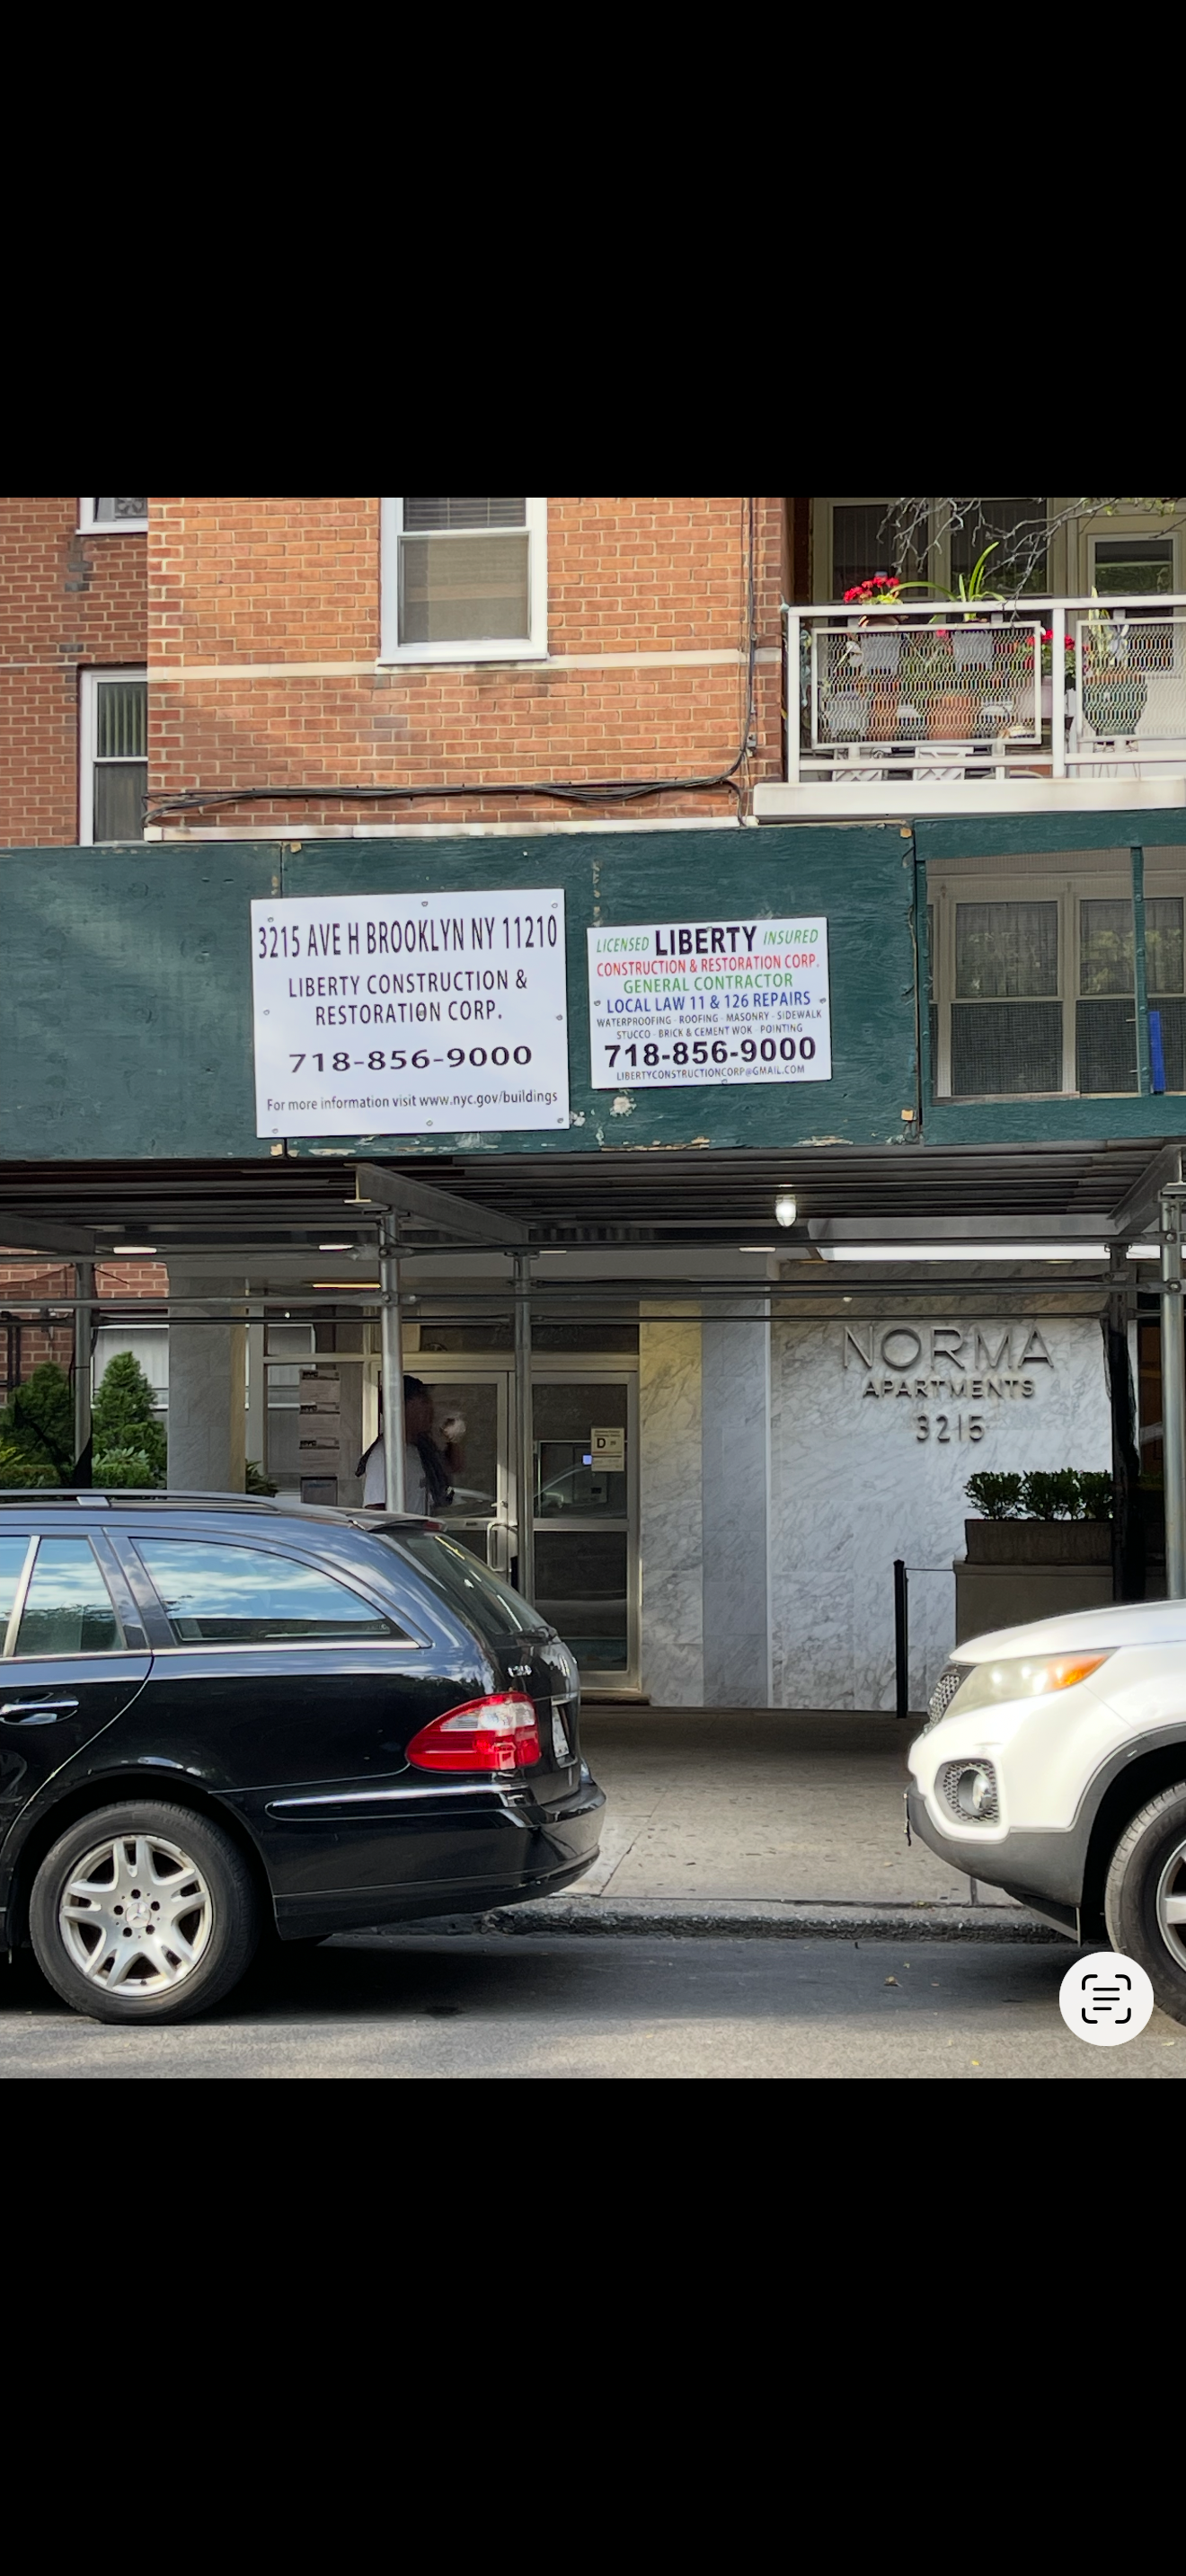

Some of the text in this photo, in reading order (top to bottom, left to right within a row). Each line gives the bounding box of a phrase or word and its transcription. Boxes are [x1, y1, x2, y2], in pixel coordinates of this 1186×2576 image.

[259, 914, 557, 958] 3215 AVE H BROOKLYN NY 11210
[597, 937, 649, 953] LICENSED
[656, 926, 757, 956] LIBERTY
[764, 930, 819, 945] INSURED
[597, 954, 819, 976] CONSTRUCTION & RESTORATION CORP.
[289, 969, 527, 998] LIBERTY CONSTRUCTION &
[624, 974, 792, 993] GENERAL CONTRACTOR
[316, 1000, 502, 1026] RESTORATION CORP.
[607, 992, 810, 1013] LOCAL LAW 11 & 126 REPAIRS
[597, 1016, 671, 1028] WATERPROOFING
[679, 1014, 718, 1023] ROOFING
[727, 1011, 768, 1022] MASONRY
[777, 1010, 821, 1019] SIDEWALK
[616, 1029, 651, 1039] STUCCO
[659, 1028, 683, 1037] BRICK
[686, 1028, 692, 1037] &
[695, 1026, 729, 1037] CEMENT
[731, 1026, 752, 1036] WOK
[760, 1023, 802, 1034] POINTING
[289, 1045, 532, 1072] 718-856-9000
[605, 1037, 816, 1068] 718-856-9000
[617, 1065, 804, 1081] LIBERTYCONSTRUCTIONCORP@GMAIL.COM
[268, 1090, 558, 1111] For more information visit www.nyc.gov/buildings
[843, 1326, 1054, 1371] NORMA
[863, 1380, 1034, 1398] APARTMENTS
[916, 1414, 987, 1442] 3215
[597, 1438, 606, 1448] D
